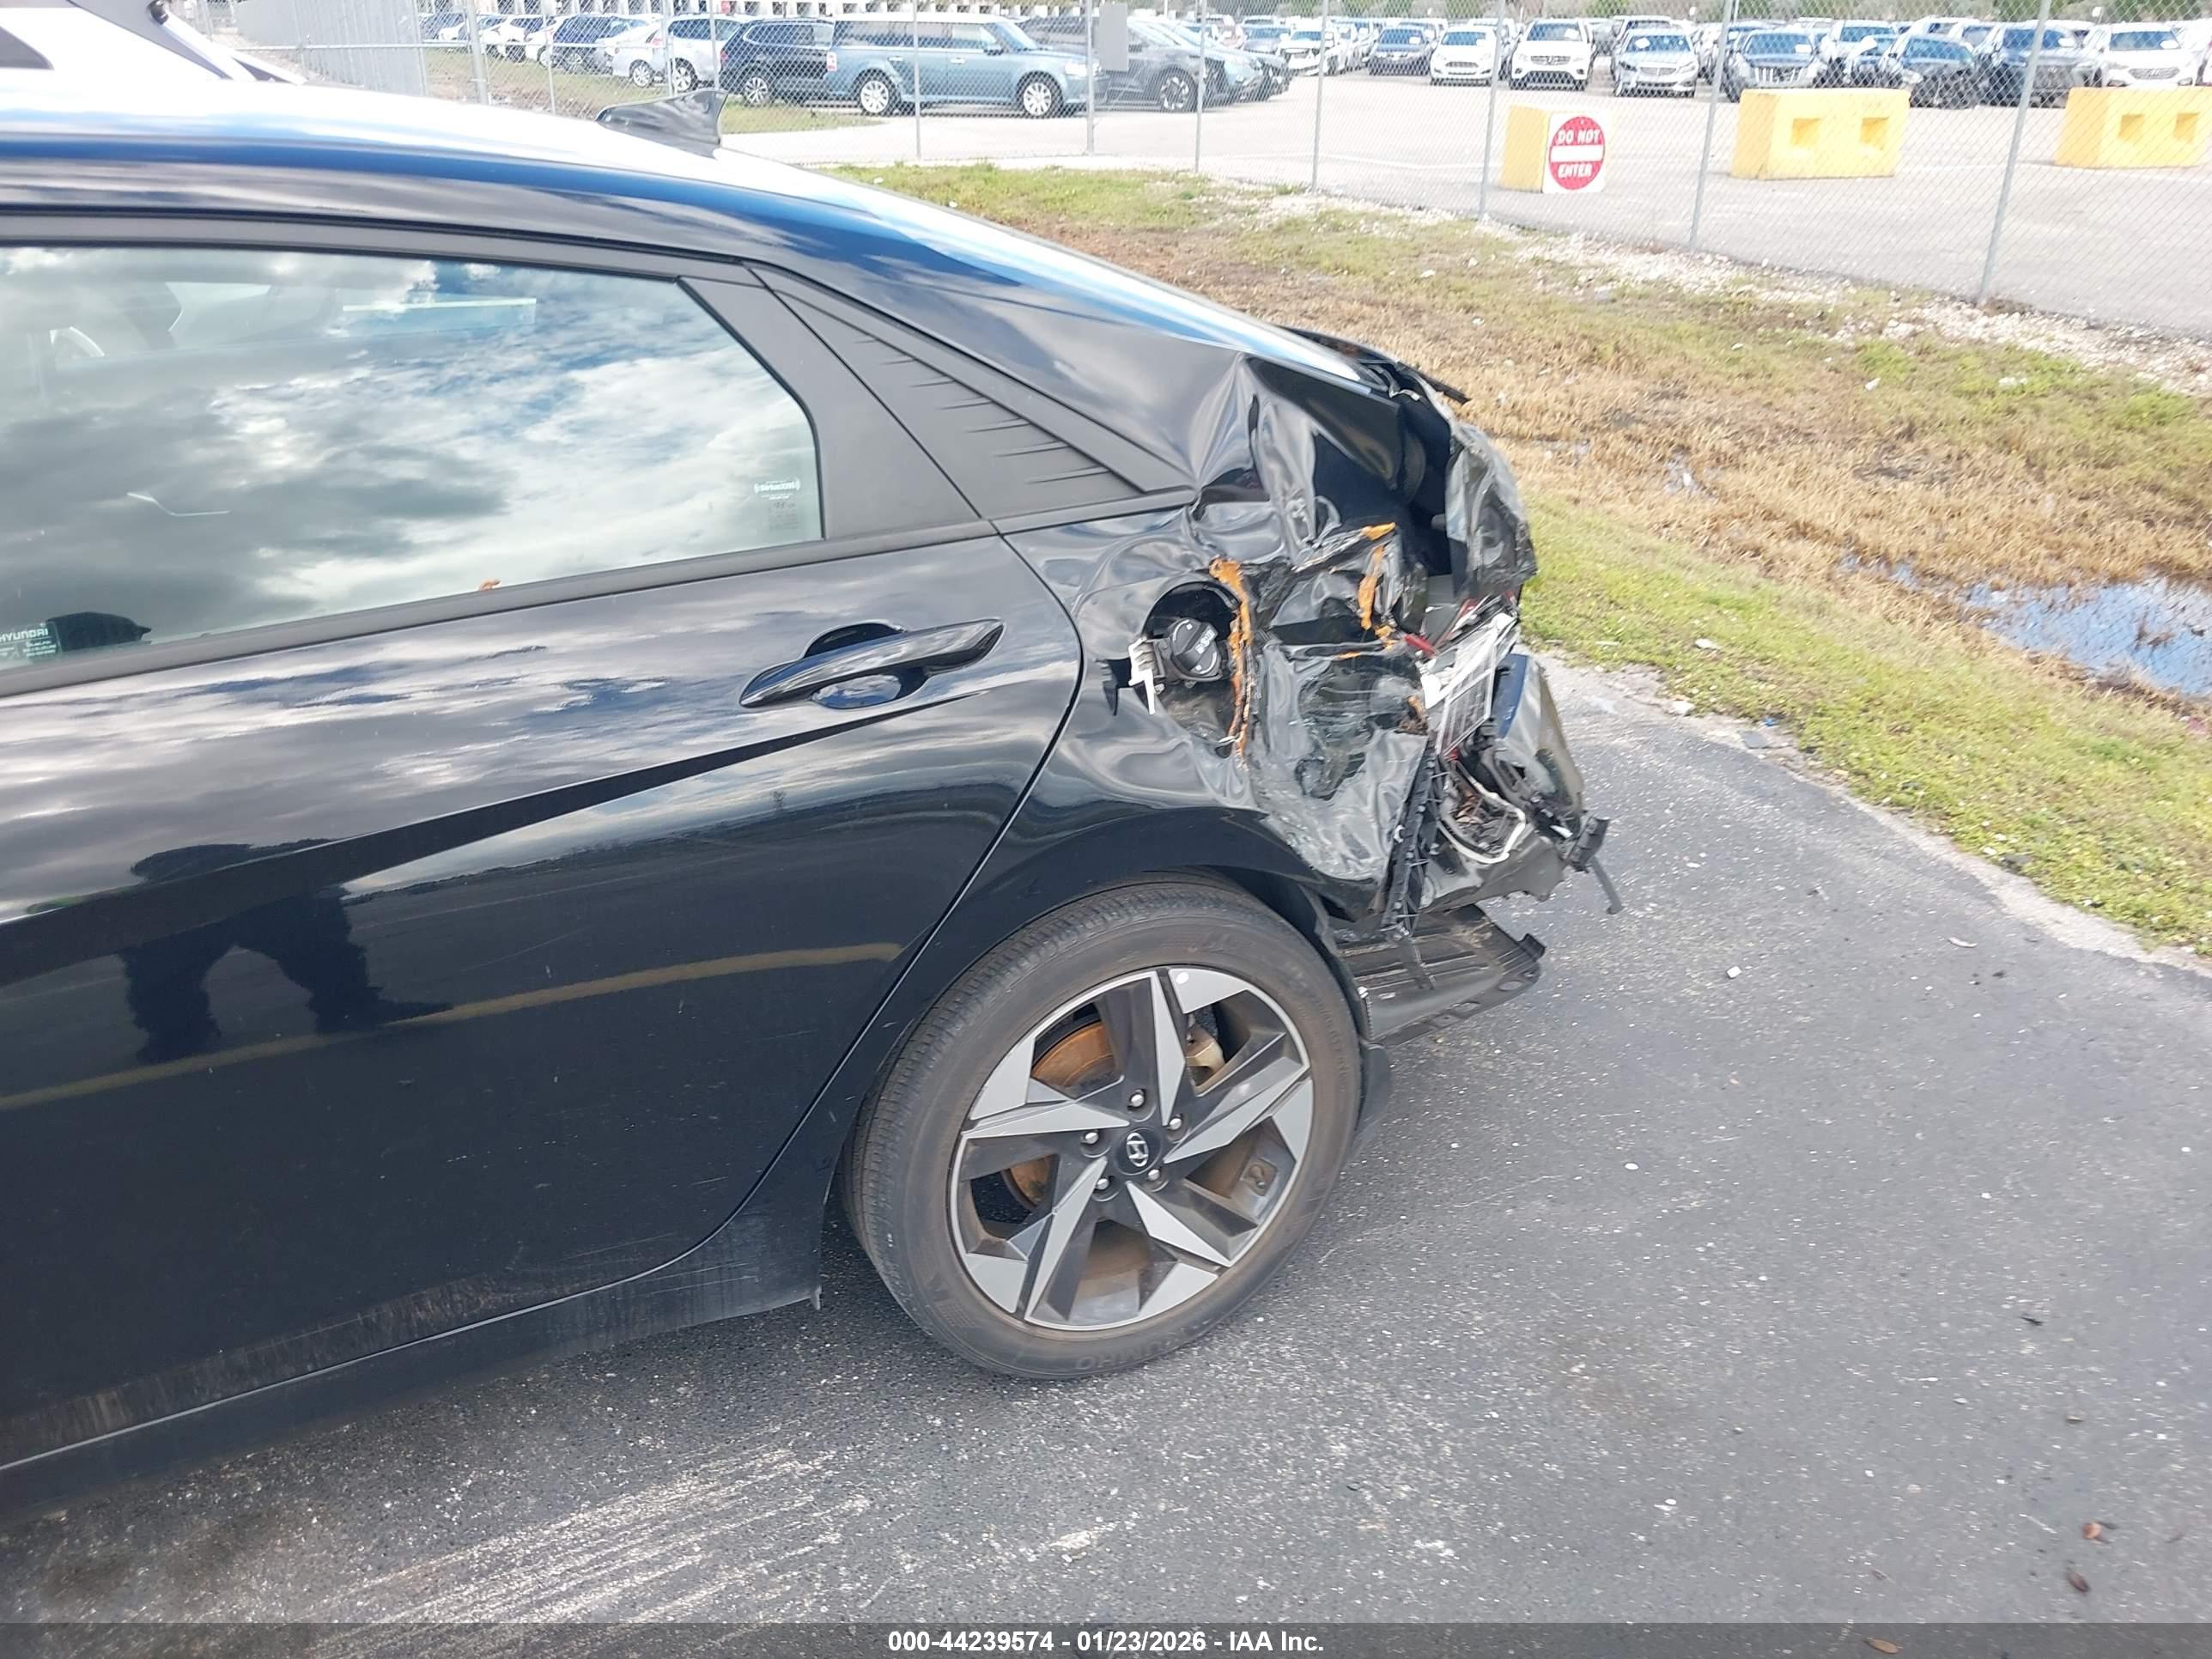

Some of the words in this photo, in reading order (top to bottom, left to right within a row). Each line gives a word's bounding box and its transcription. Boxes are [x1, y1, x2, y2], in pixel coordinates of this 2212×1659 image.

[1558, 130, 1573, 143] DO
[1577, 129, 1601, 143] NOT
[1559, 165, 1593, 177] ENTER
[0, 629, 48, 641] HYUNDAI
